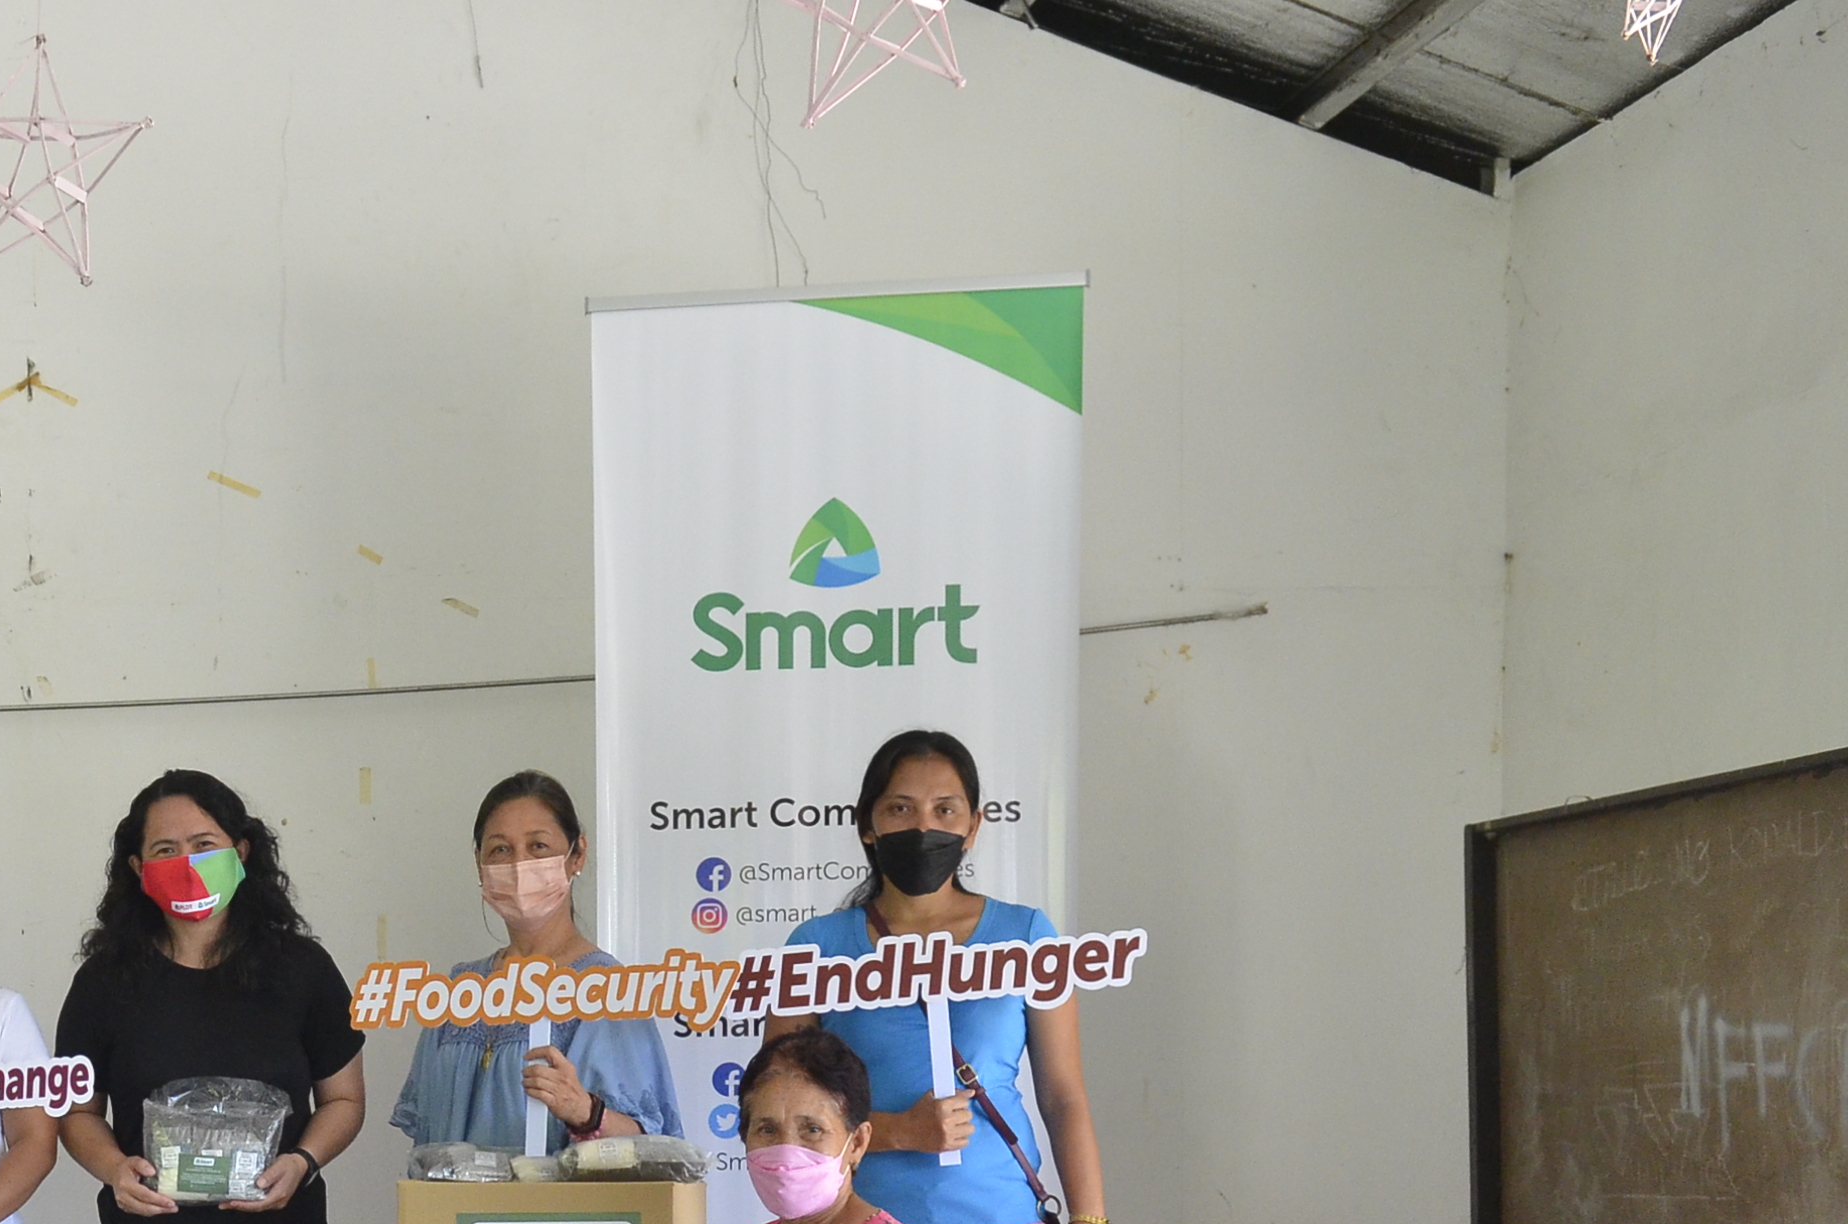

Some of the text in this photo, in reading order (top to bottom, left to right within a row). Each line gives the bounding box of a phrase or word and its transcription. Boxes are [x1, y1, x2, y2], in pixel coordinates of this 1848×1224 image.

[691, 580, 980, 672] Smart
[650, 801, 758, 831] Smart
[357, 954, 732, 1026] #FoodSecurity
[730, 931, 1141, 1013] #EndHunger
